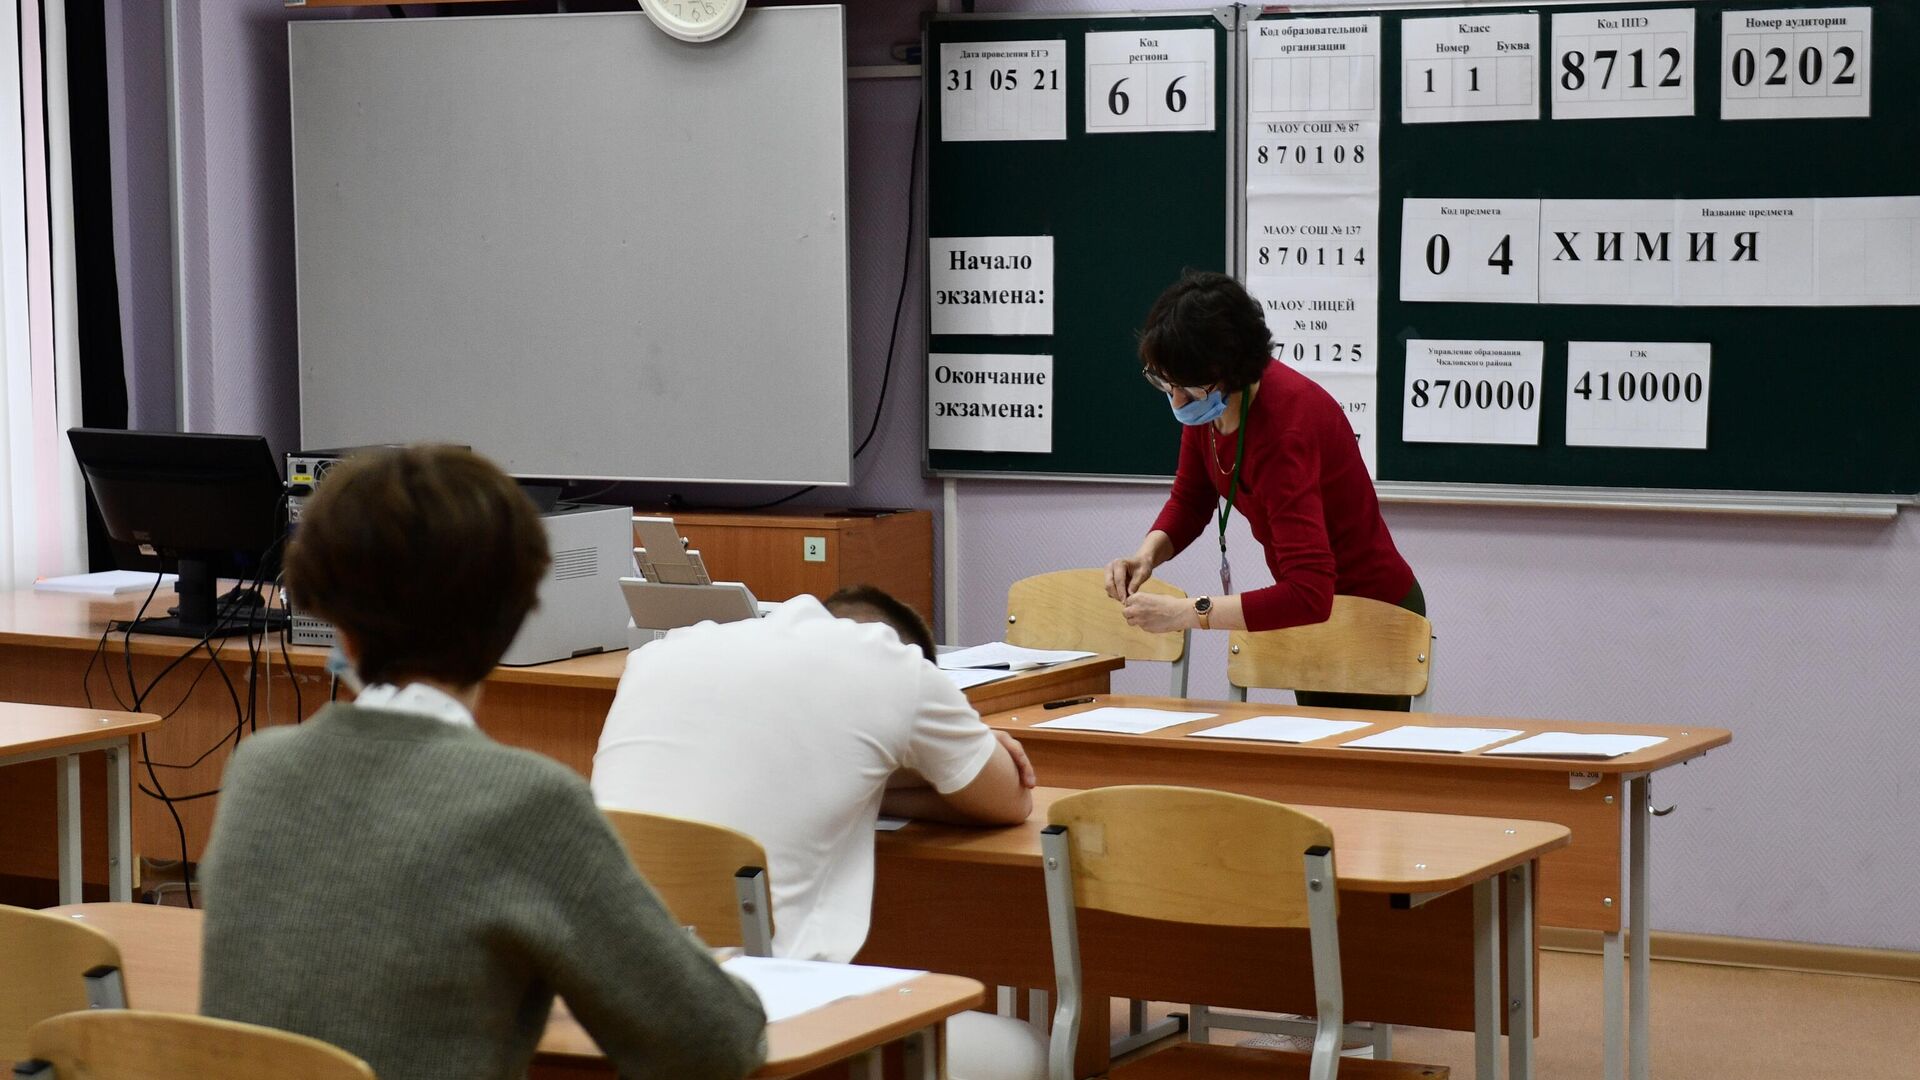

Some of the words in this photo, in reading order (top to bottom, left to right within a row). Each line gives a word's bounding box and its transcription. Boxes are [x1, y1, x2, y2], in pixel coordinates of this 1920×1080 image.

[1458, 23, 1491, 34] Класс
[1597, 18, 1618, 29] Код
[1621, 17, 1649, 28] ППЭ
[1745, 17, 1781, 30] Номер
[1785, 17, 1847, 30] аудитории
[1260, 26, 1279, 37] Код
[1281, 23, 1368, 38] образовательной
[1139, 37, 1159, 48] Код
[1280, 43, 1346, 54] организации
[1436, 42, 1470, 55] Номер
[1496, 40, 1531, 53] Буква
[959, 49, 980, 60] Дата
[980, 51, 1029, 60] проведения
[1030, 49, 1049, 58] ЕГЭ
[1128, 53, 1169, 64] региона
[1560, 47, 1682, 91] 8712
[1731, 45, 1856, 87] 0202
[946, 68, 973, 91] 31
[989, 68, 1018, 91] 05
[1033, 68, 1058, 91] 21
[1267, 123, 1300, 134] МАОУ
[1302, 122, 1332, 134] СОШ
[1334, 122, 1347, 133] №
[1348, 122, 1360, 133] 87
[1440, 206, 1458, 216] Код
[1459, 208, 1501, 217] предмета
[1701, 208, 1747, 217] Название
[1748, 209, 1794, 219] предмета
[1263, 225, 1296, 235] МАОУ
[1299, 225, 1329, 235] СОШ
[1330, 225, 1343, 235] №
[1345, 225, 1362, 235] 137
[949, 250, 1033, 271] Начало
[935, 289, 1045, 305] экзамена:
[1267, 300, 1305, 311] МАОУ
[1308, 298, 1355, 312] ЛИЦЕЙ
[1293, 320, 1306, 331] №
[1310, 320, 1328, 331] 180
[1428, 347, 1473, 357] Управление
[1473, 348, 1521, 357] образования
[1629, 350, 1647, 358] ГЭК
[1436, 358, 1484, 367] Чкаловского
[1485, 359, 1513, 368] района
[934, 365, 1046, 386] Окончание
[1573, 370, 1703, 403] 410000
[1410, 378, 1535, 411] 870000
[935, 401, 1044, 419] экзамена:
[1349, 402, 1367, 413] 197
[809, 544, 817, 556] 2
